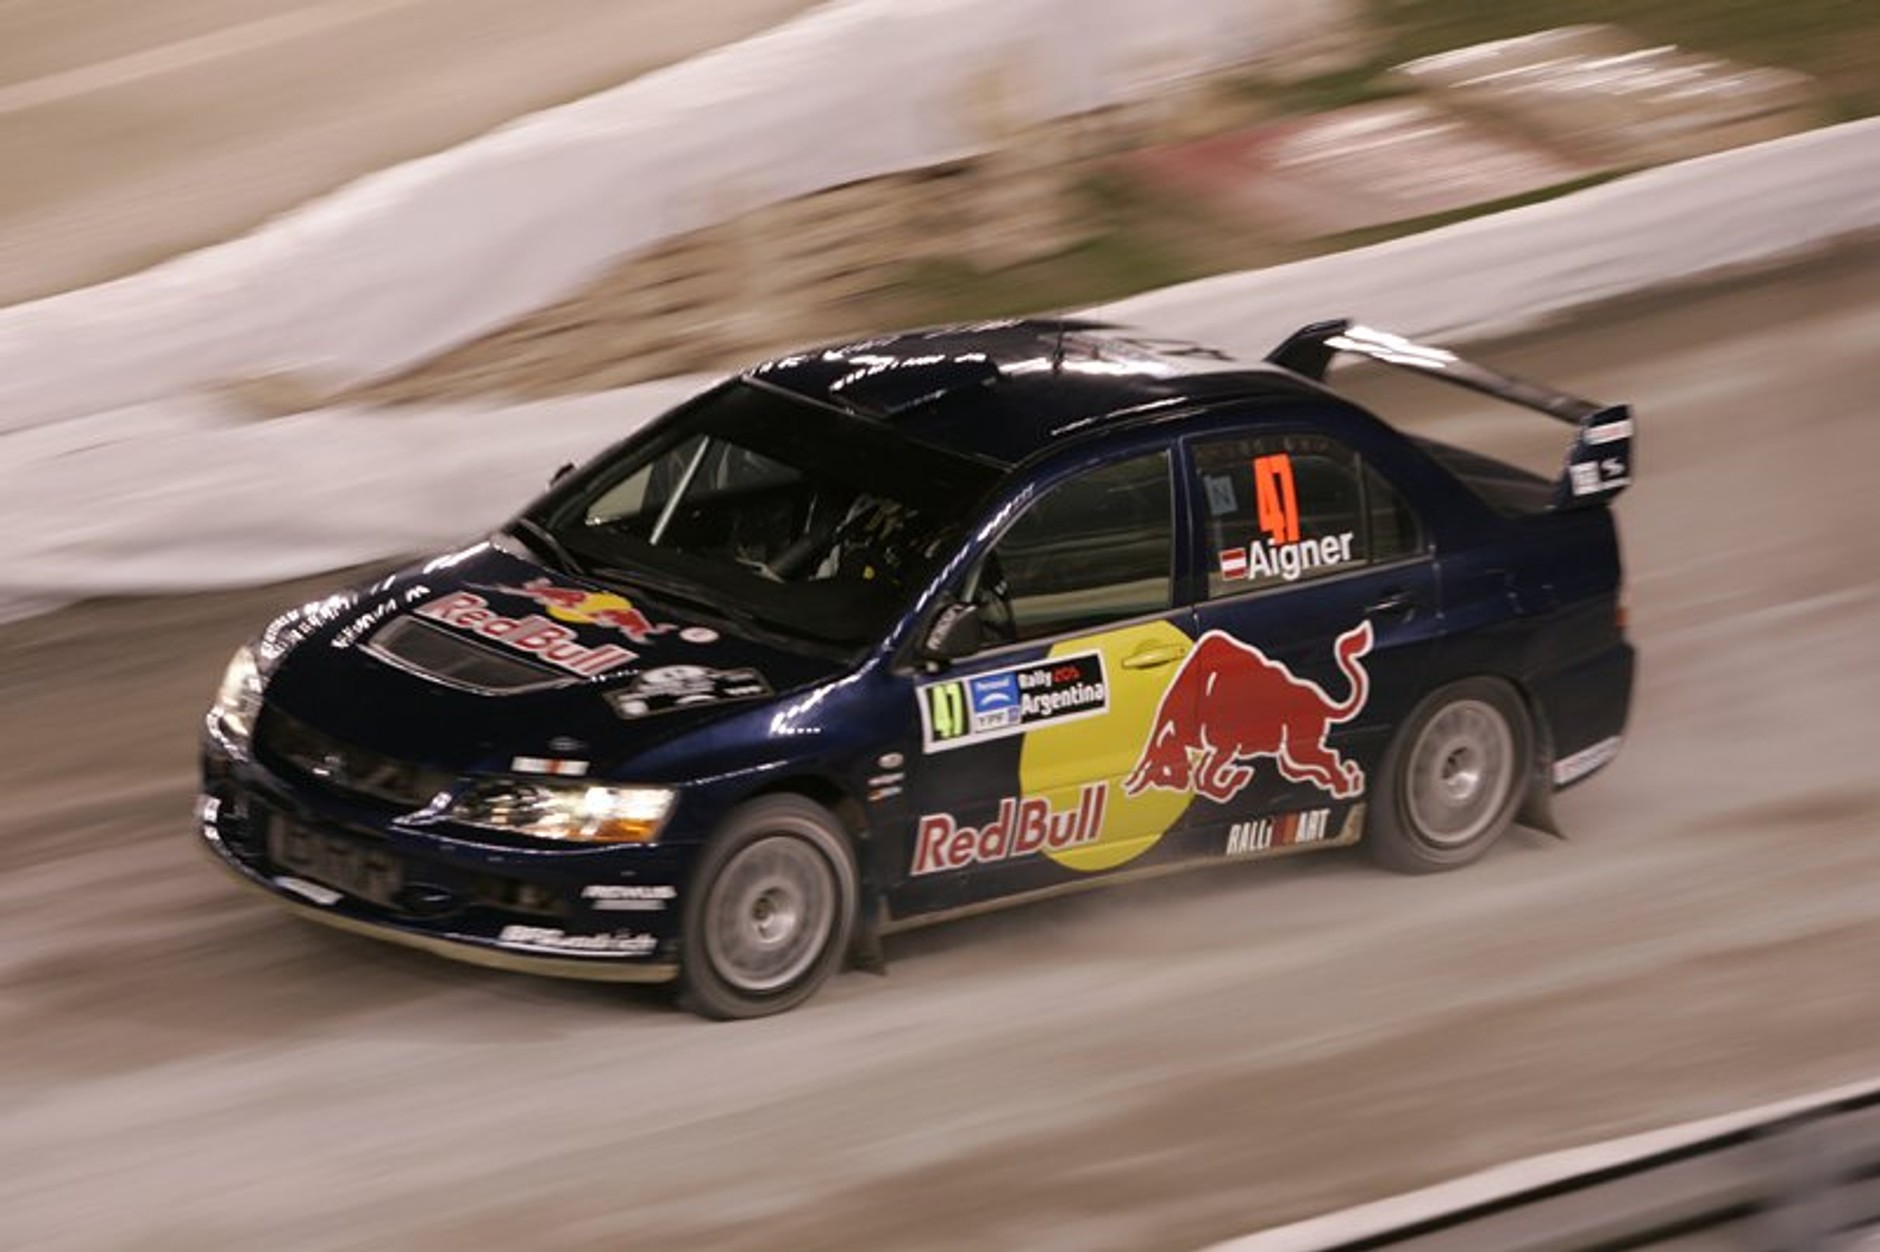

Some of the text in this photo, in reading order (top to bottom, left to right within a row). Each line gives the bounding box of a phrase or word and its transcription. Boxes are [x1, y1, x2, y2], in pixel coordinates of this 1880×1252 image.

[1254, 453, 1300, 544] 47
[1248, 532, 1354, 580] Aigner
[1018, 670, 1052, 689] Rally
[1020, 683, 1104, 715] Argentina
[933, 682, 962, 738] 47
[910, 780, 1110, 876] Red Bull
